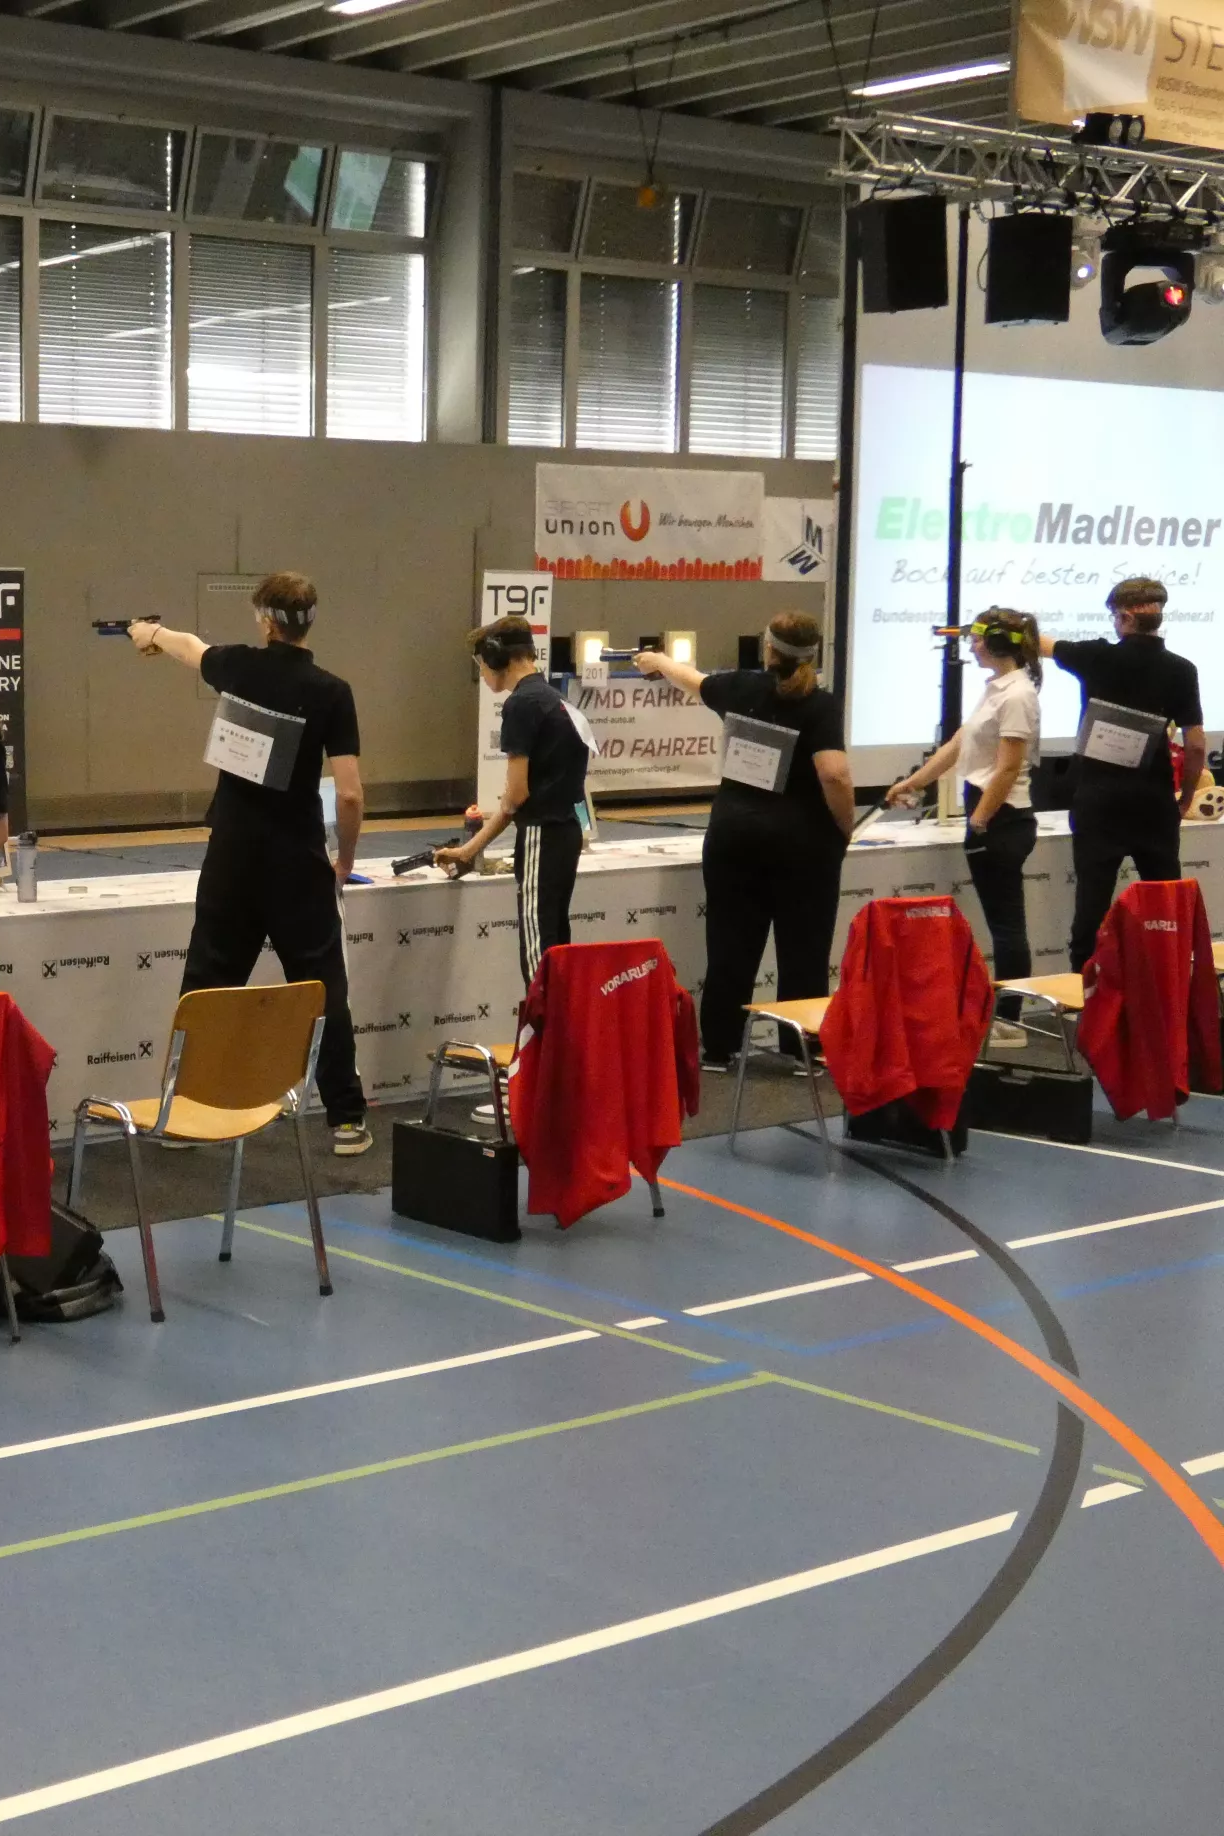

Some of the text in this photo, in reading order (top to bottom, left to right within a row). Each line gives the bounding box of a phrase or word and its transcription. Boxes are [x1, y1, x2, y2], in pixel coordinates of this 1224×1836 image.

[545, 518, 615, 537] union
[965, 559, 1014, 584] auf
[1021, 558, 1100, 585] besten
[585, 668, 603, 680] 201
[412, 924, 455, 936] Raiffeisen
[491, 919, 518, 930] ffeisen
[154, 948, 188, 960] ffeisen
[60, 955, 110, 969] Raiffeisen
[434, 1013, 476, 1026] Raiffeisen
[354, 1022, 396, 1035] Raiffeisen
[87, 1051, 137, 1065] Raiffeisen
